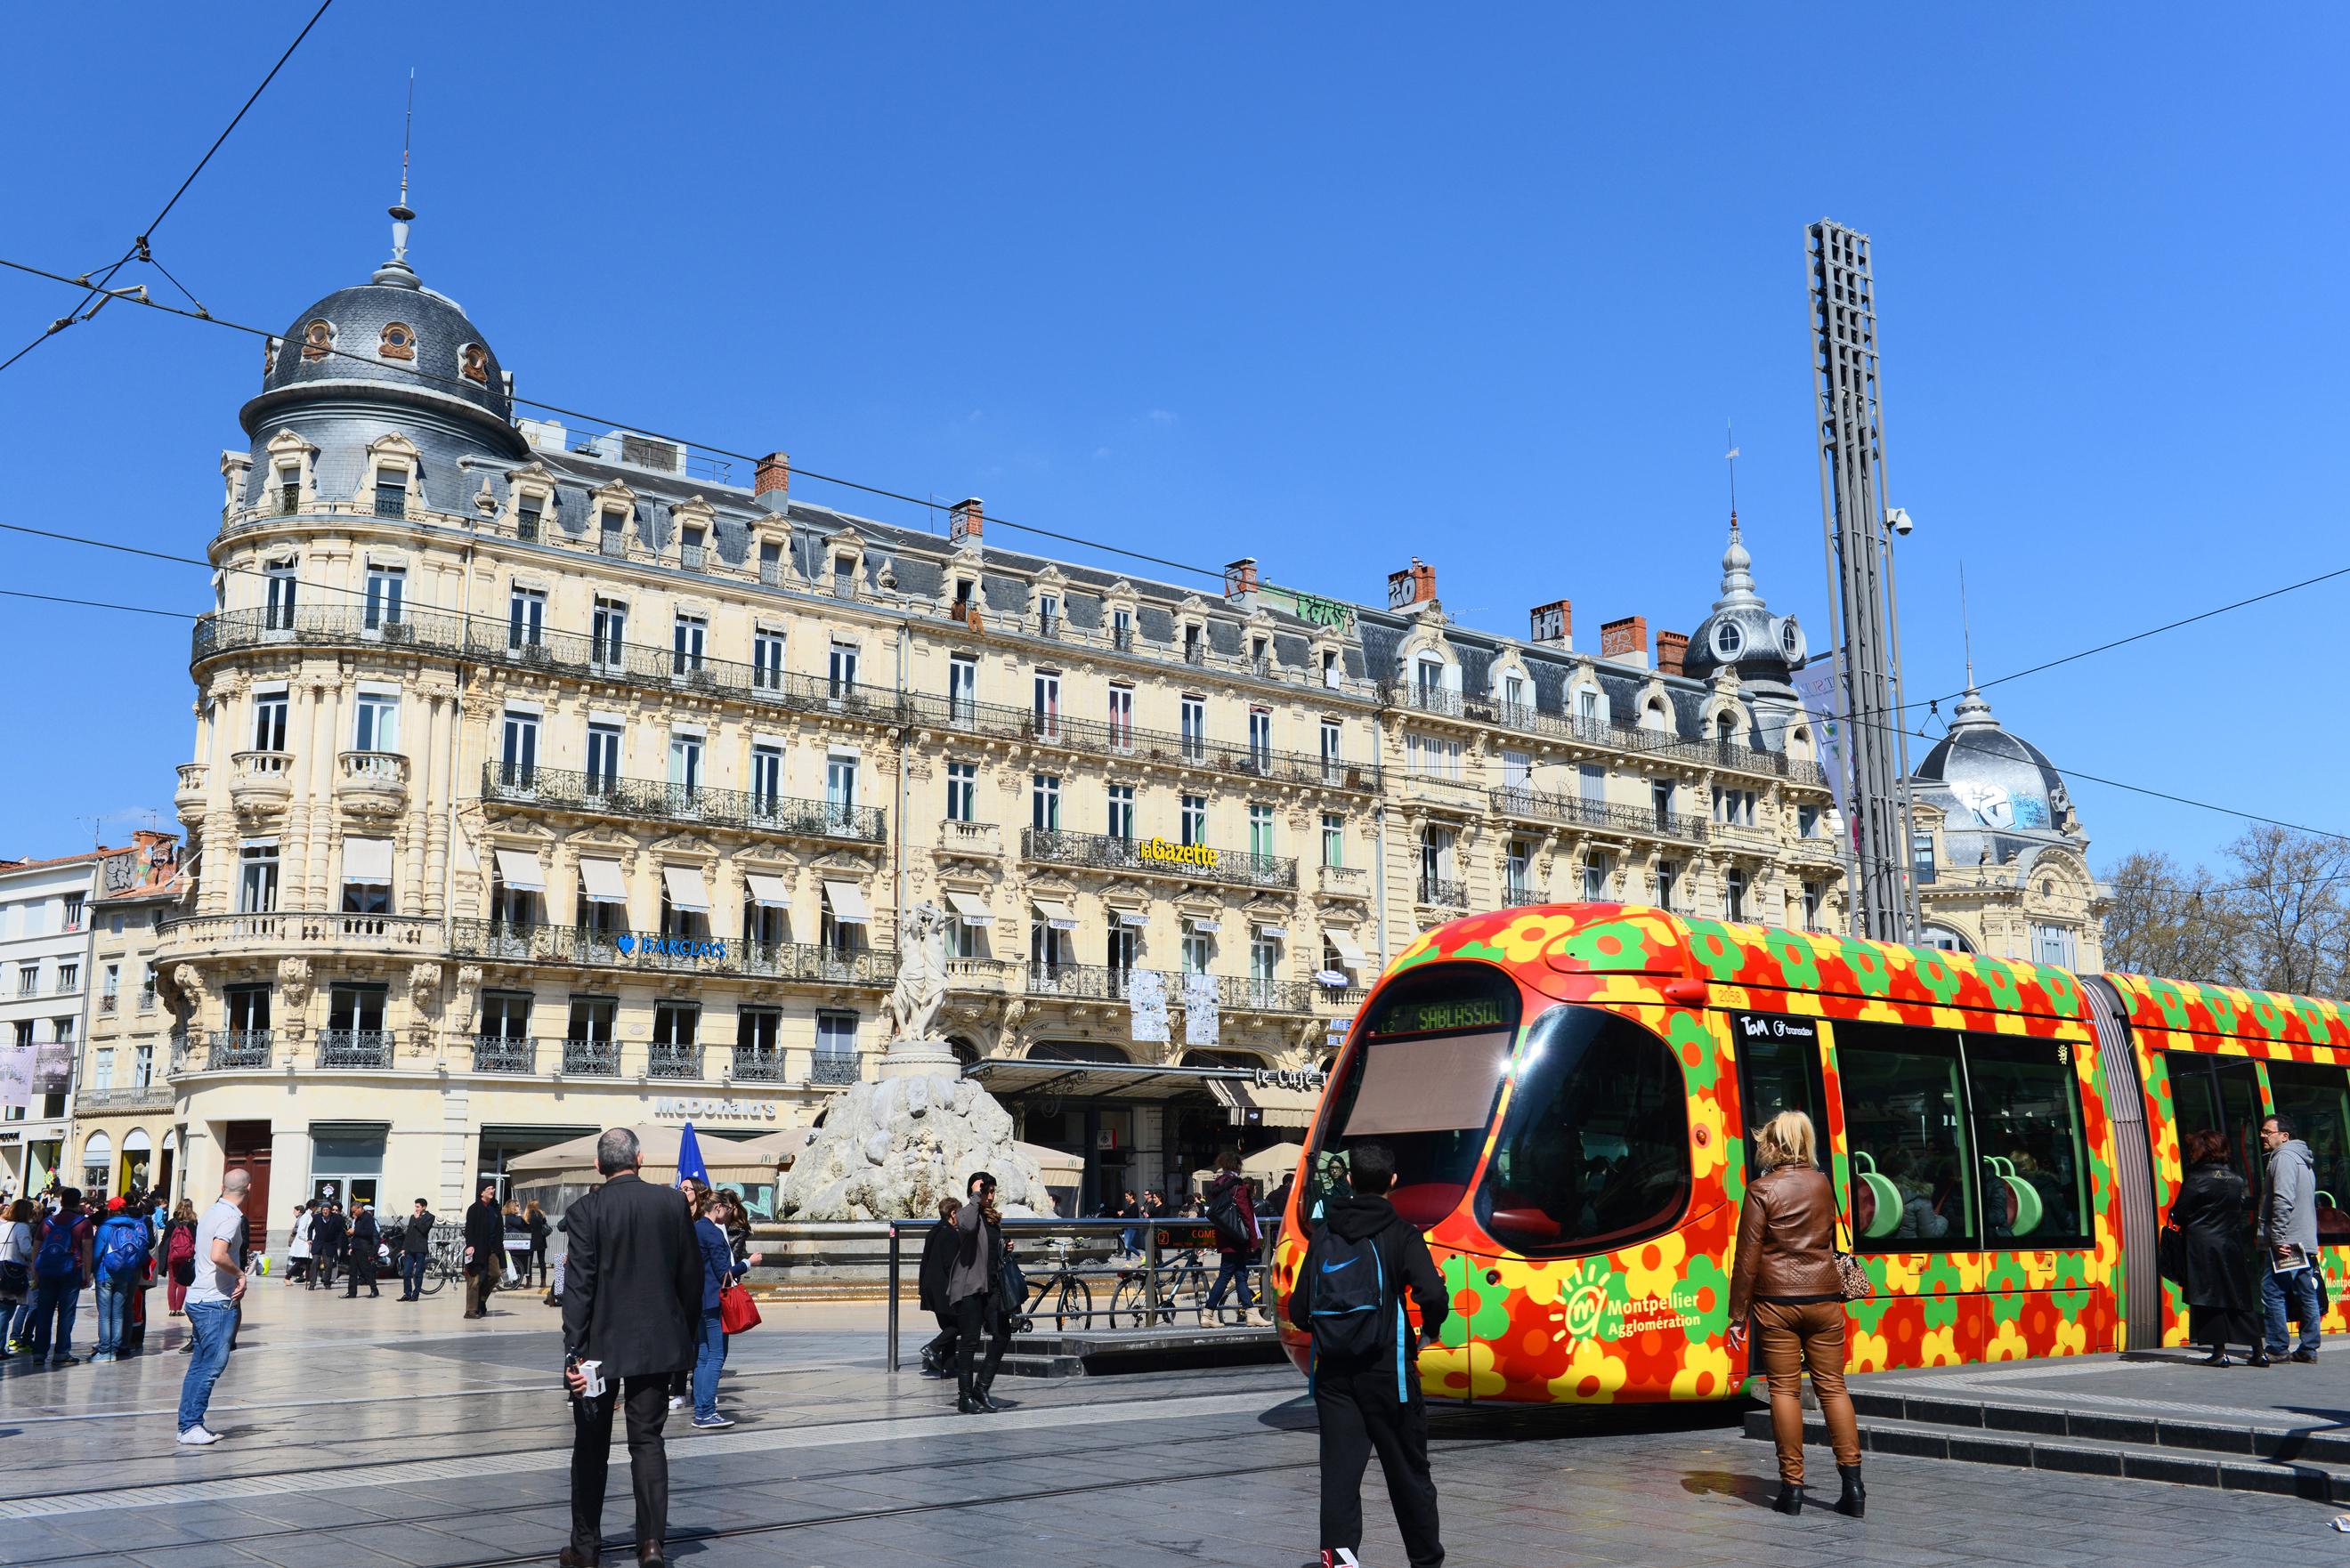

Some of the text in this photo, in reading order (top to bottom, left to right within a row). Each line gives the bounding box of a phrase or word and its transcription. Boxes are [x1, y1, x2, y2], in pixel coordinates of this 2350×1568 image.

[641, 936, 727, 958] BARCLAYS
[1718, 989, 1742, 1004] 2058
[1785, 1024, 1813, 1037] transdev
[1277, 1070, 1313, 1088] Café
[655, 1097, 776, 1118] McDonald's
[1607, 1291, 1699, 1316] Montpellier
[1608, 1314, 1701, 1338] Agglomération
